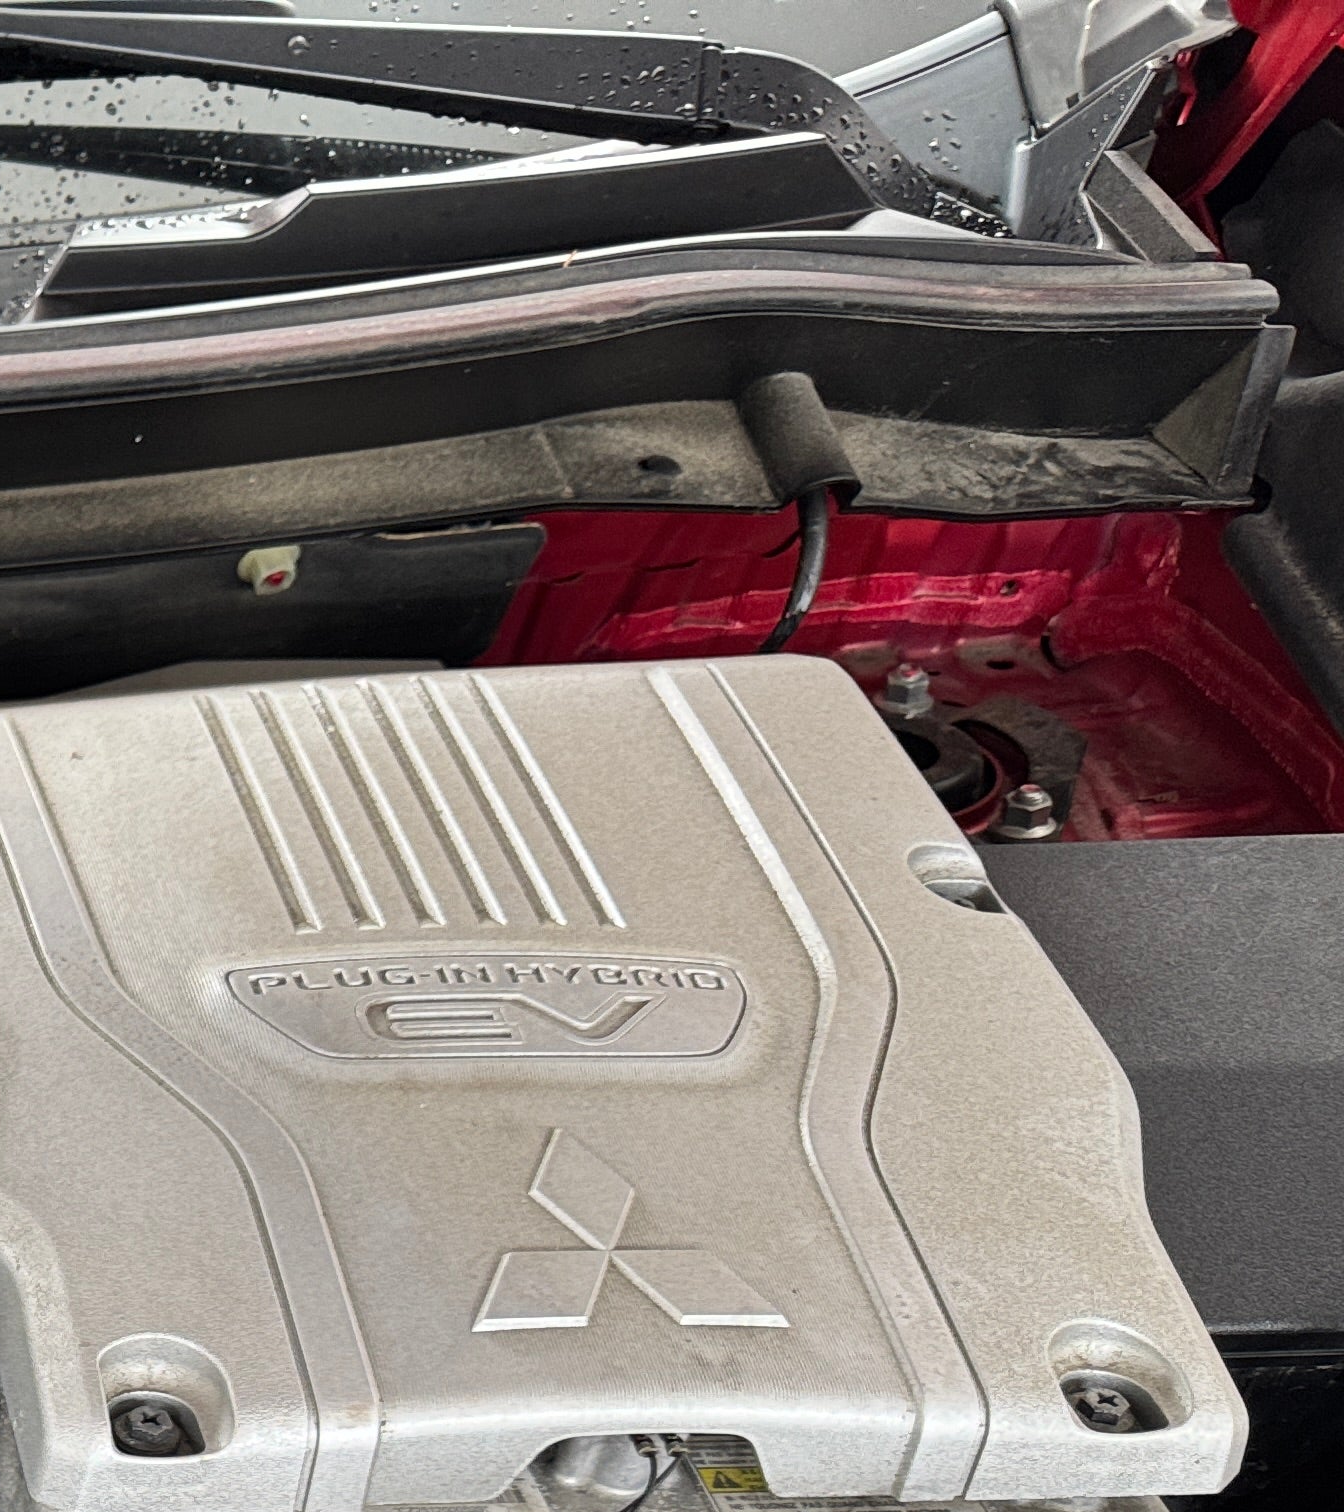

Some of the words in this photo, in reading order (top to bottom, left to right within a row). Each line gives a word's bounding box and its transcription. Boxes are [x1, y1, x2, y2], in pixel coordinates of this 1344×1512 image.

[248, 964, 492, 996] PLUG-IN
[506, 962, 727, 991] HYBRID
[360, 993, 662, 1044] EV
